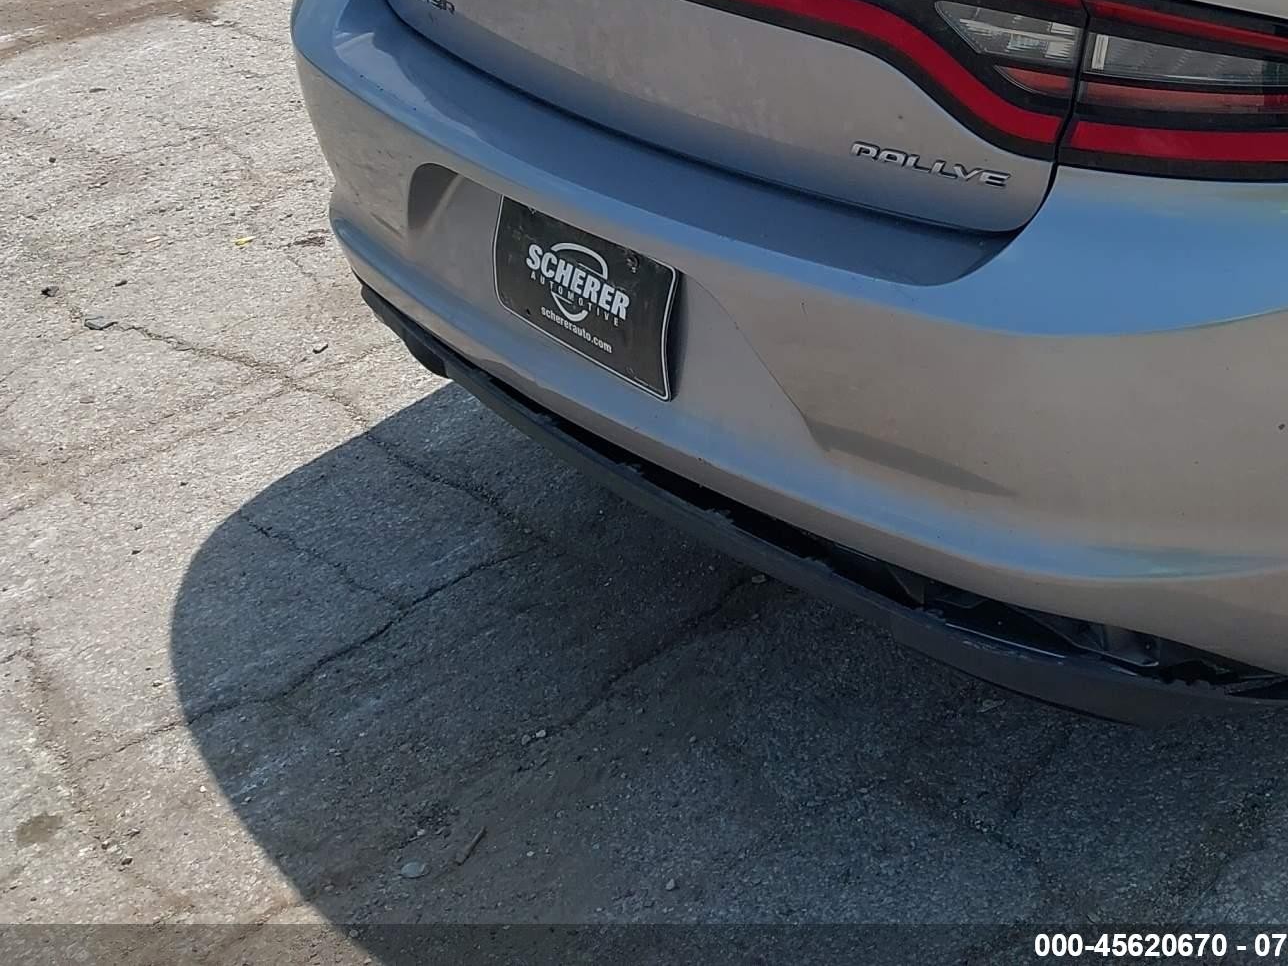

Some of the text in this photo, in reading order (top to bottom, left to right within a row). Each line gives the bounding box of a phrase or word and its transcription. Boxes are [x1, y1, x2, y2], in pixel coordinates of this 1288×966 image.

[526, 244, 630, 320] SCHERER
[531, 270, 619, 327] AUTOMOTIVE
[541, 306, 613, 354] schererauto.com
